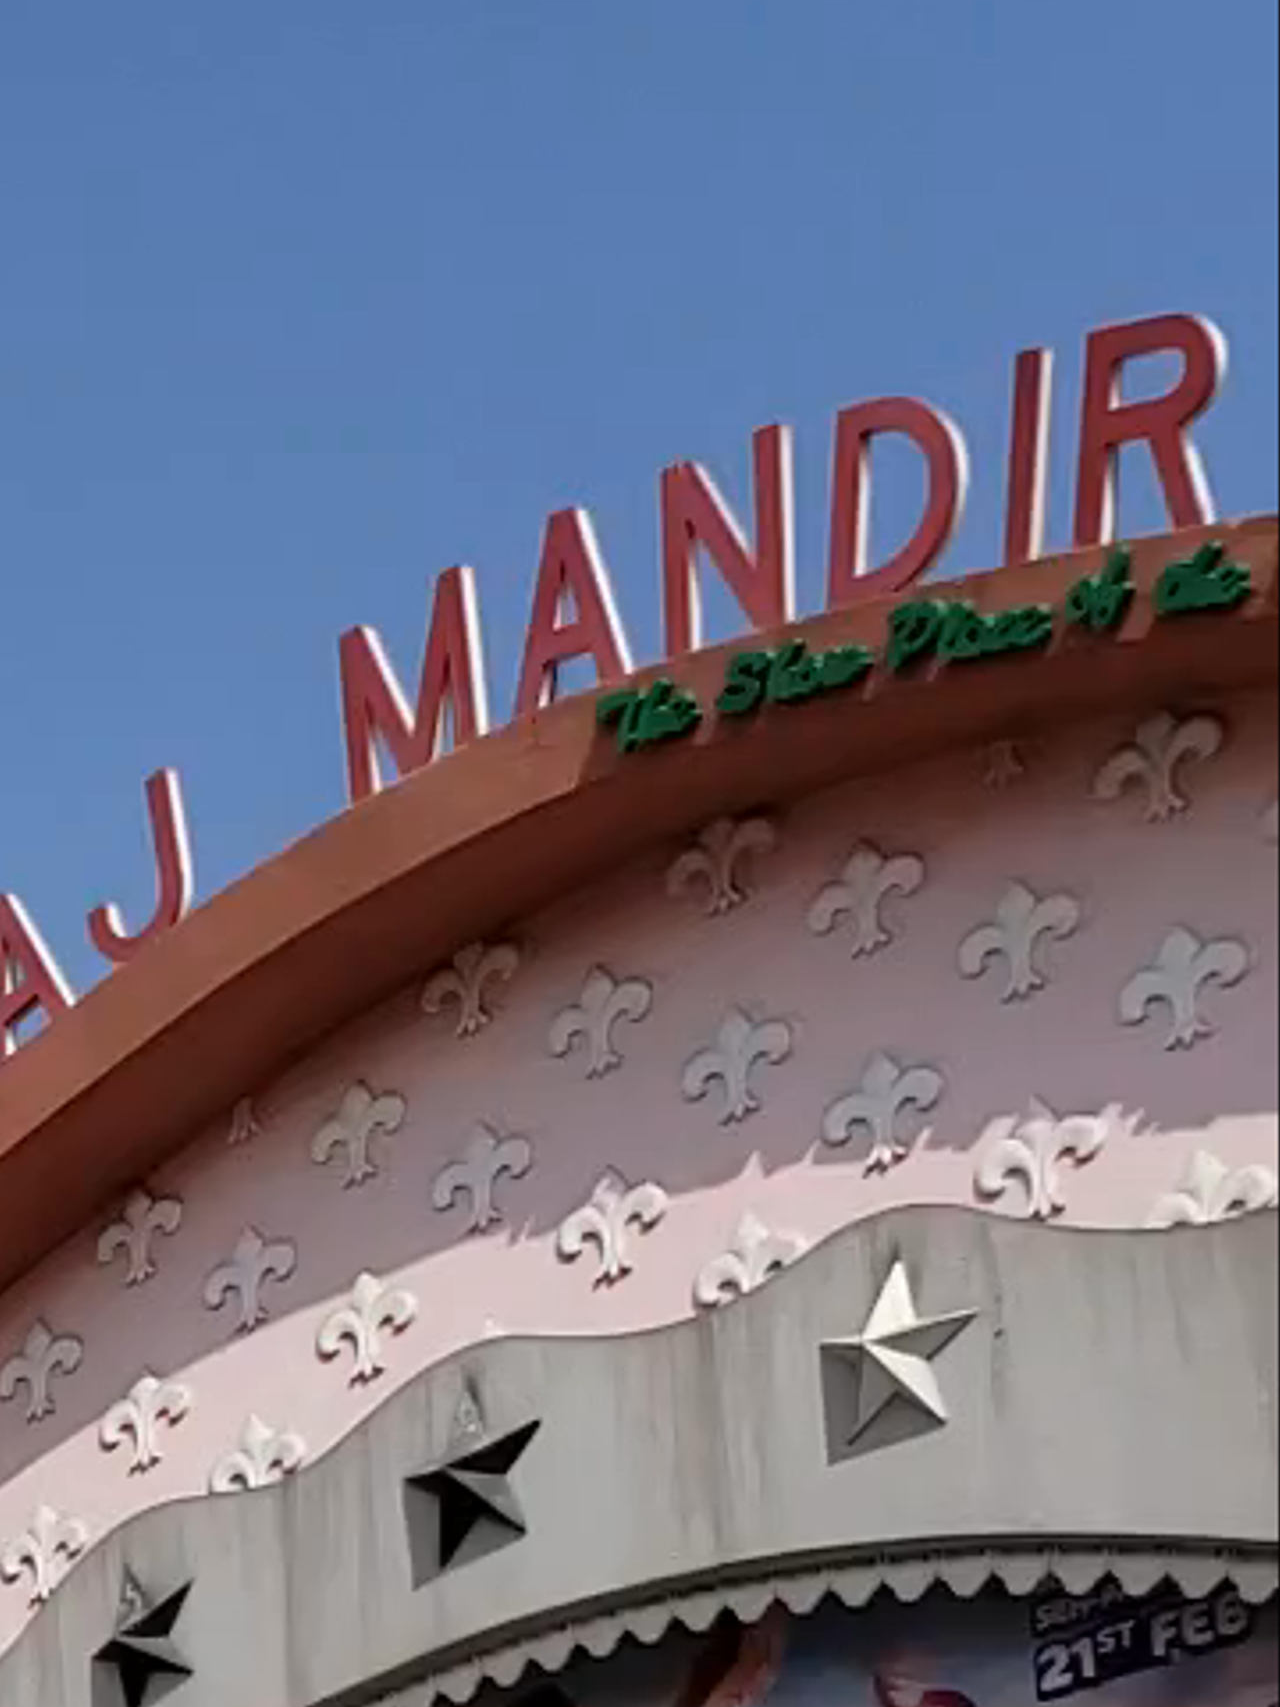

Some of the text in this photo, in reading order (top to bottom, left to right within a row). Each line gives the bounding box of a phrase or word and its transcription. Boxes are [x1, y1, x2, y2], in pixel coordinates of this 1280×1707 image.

[338, 312, 1229, 801] MANDIR
[595, 677, 704, 757] The
[1066, 541, 1136, 627] of
[1150, 1592, 1249, 1657] FEB
